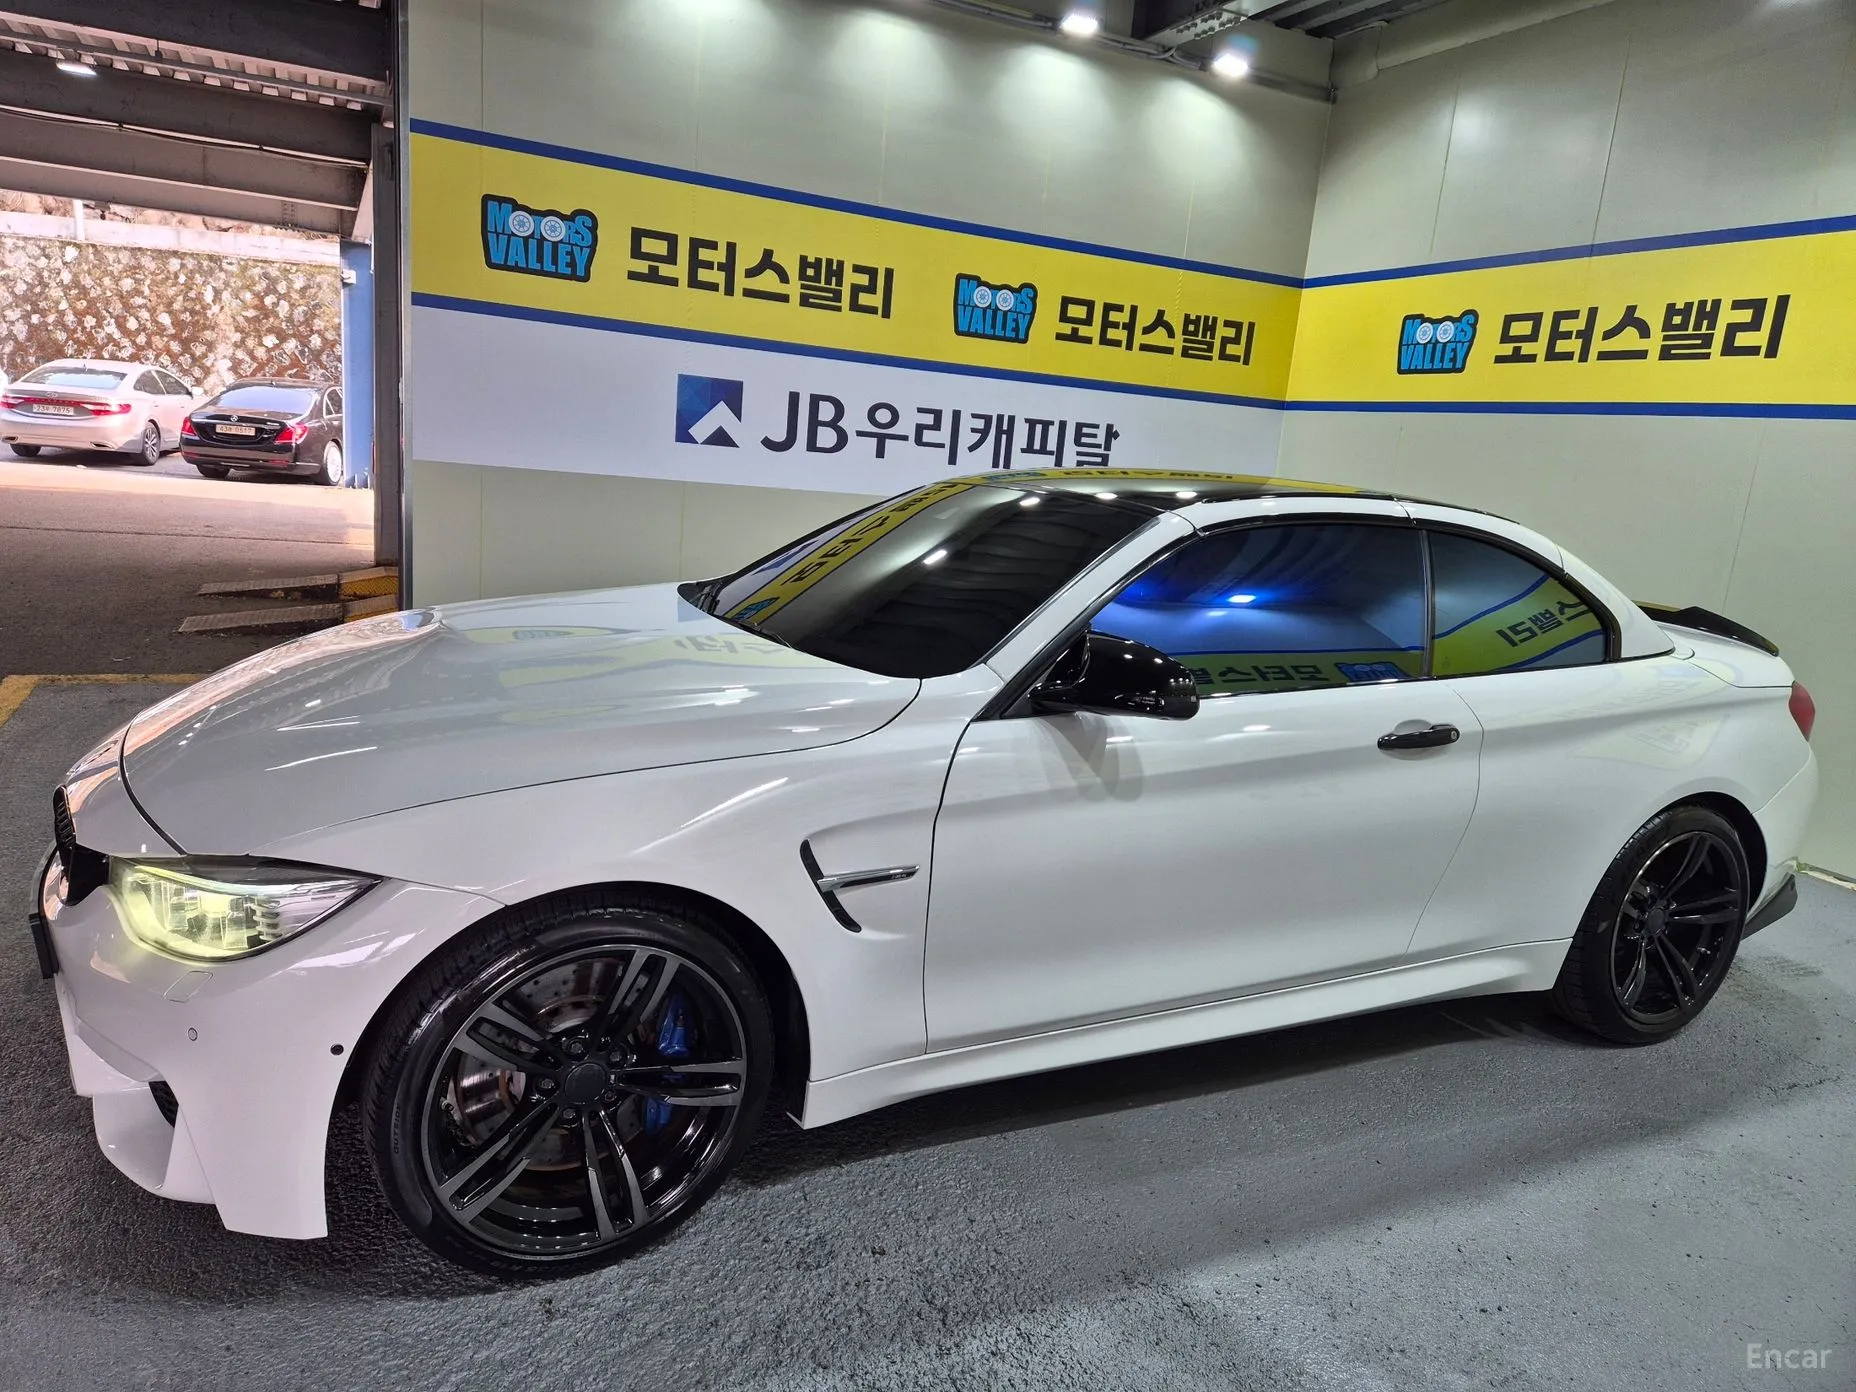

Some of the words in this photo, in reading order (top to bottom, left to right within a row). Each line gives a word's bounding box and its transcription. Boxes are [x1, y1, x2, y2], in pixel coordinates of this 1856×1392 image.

[487, 200, 592, 247] MOTORS
[487, 232, 590, 277] VALLEY
[626, 226, 895, 320] 모터스밸리
[957, 278, 1034, 313] MOTORS
[957, 304, 1031, 340] VALLEY
[1054, 295, 1256, 366] 모터스밸리
[1402, 313, 1475, 343] MOTORS
[1493, 294, 1791, 364] 모터스밸리
[1400, 342, 1469, 371] VALLEY
[759, 390, 1121, 470] JB우리캐피탈
